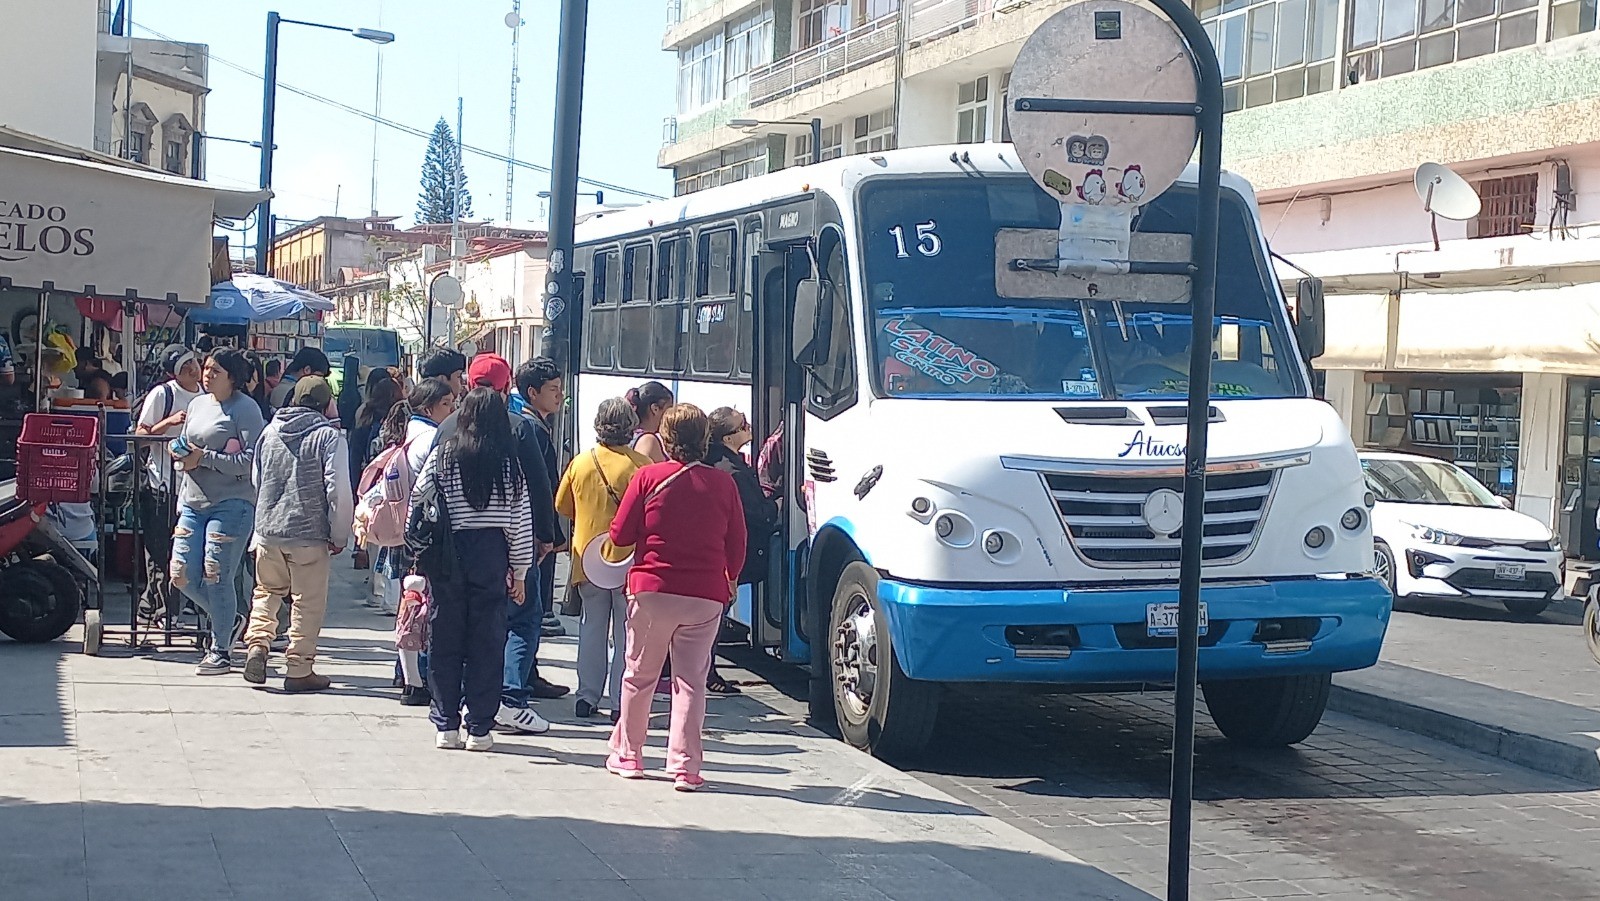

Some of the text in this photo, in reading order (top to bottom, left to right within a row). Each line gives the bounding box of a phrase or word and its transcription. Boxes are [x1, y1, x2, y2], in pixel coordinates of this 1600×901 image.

[887, 219, 942, 257] 15
[884, 319, 997, 379] LATINO
[895, 351, 956, 385] CENTRO
